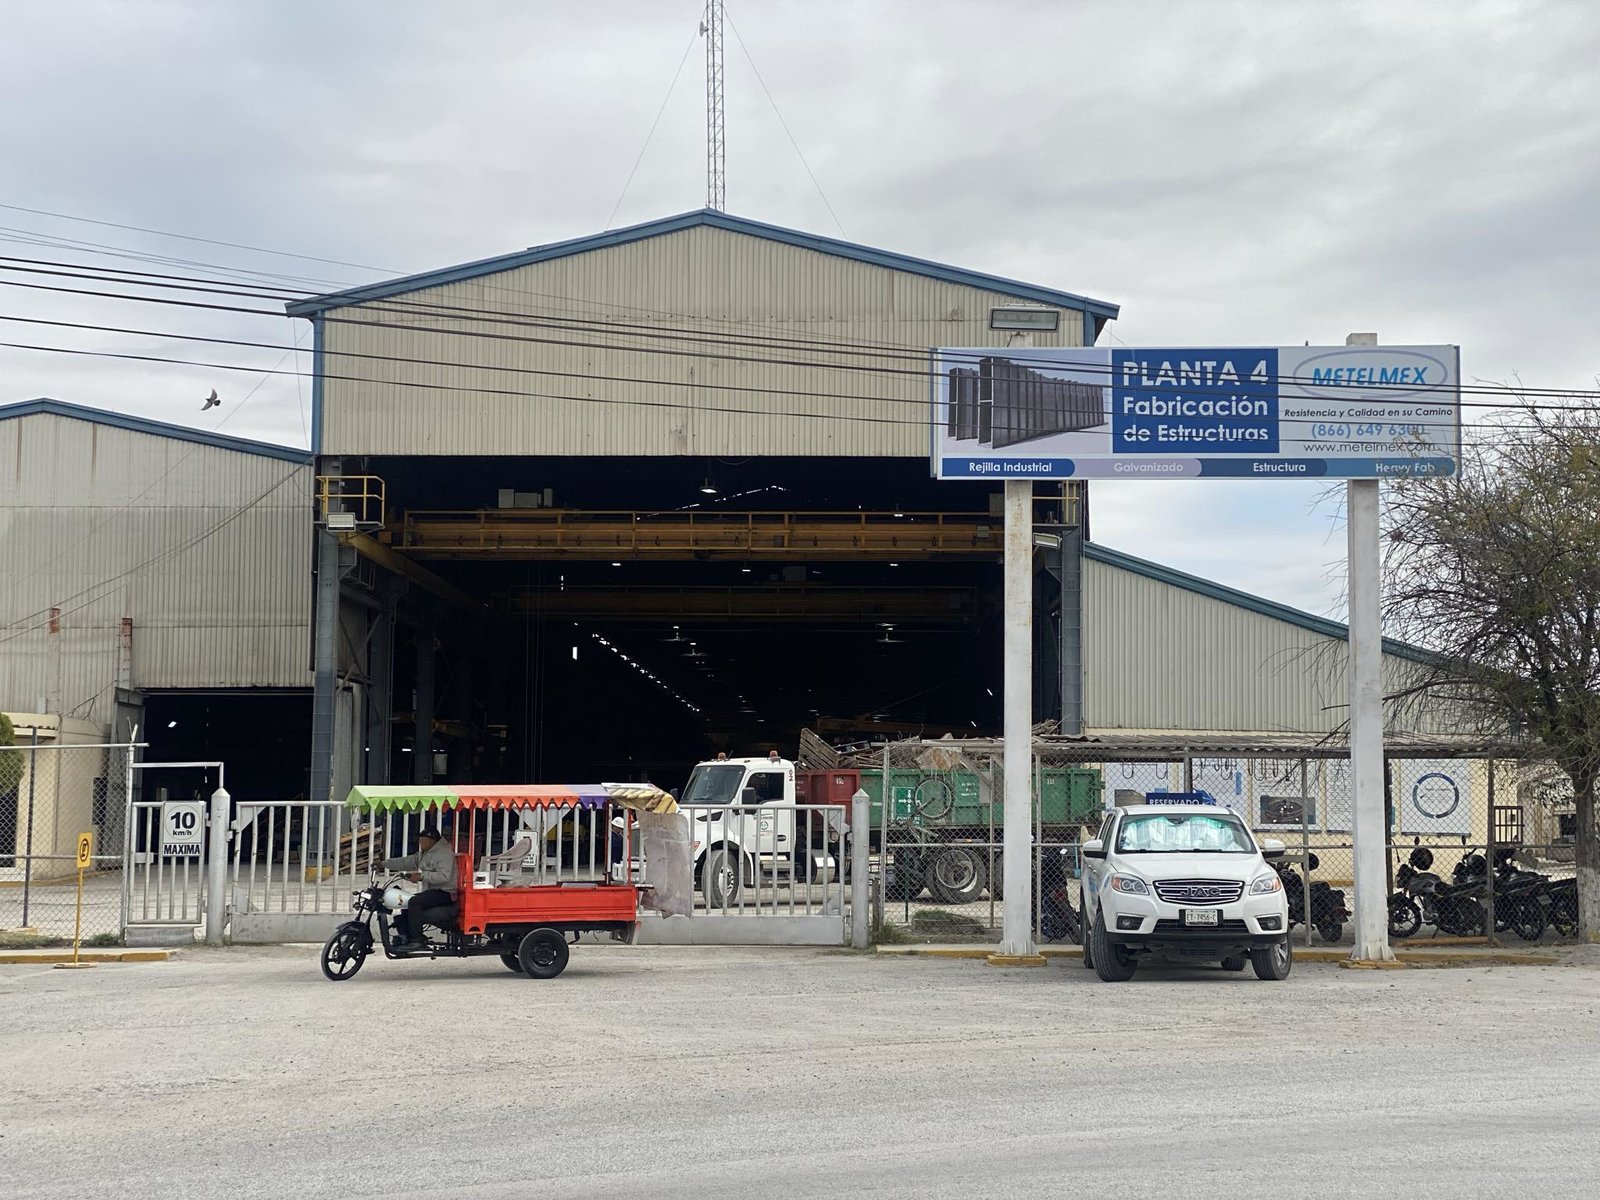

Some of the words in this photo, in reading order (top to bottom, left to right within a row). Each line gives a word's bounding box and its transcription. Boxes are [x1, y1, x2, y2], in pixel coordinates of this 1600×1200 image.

[1123, 360, 1240, 386] PLANTA
[1250, 359, 1269, 386] 4
[1313, 366, 1428, 386] METELMEX
[1123, 396, 1268, 416] Fabricación
[1284, 409, 1337, 417] Resistencia
[1347, 408, 1385, 417] Calidad
[1415, 408, 1453, 416] Camino
[1123, 425, 1151, 442] de
[1158, 424, 1269, 442] Estructuras
[1312, 423, 1351, 439] (866)
[1356, 423, 1383, 436] 649
[969, 462, 1000, 474] Rejilla
[1003, 462, 1052, 472] Industrial
[1114, 462, 1184, 472] Galvanizado
[1253, 462, 1306, 472] Estructura
[1375, 463, 1411, 473] Heavy
[1414, 463, 1435, 473] Fab
[170, 812, 196, 829] 10
[164, 844, 201, 855] MAXIMA
[1180, 887, 1221, 897] JAC
